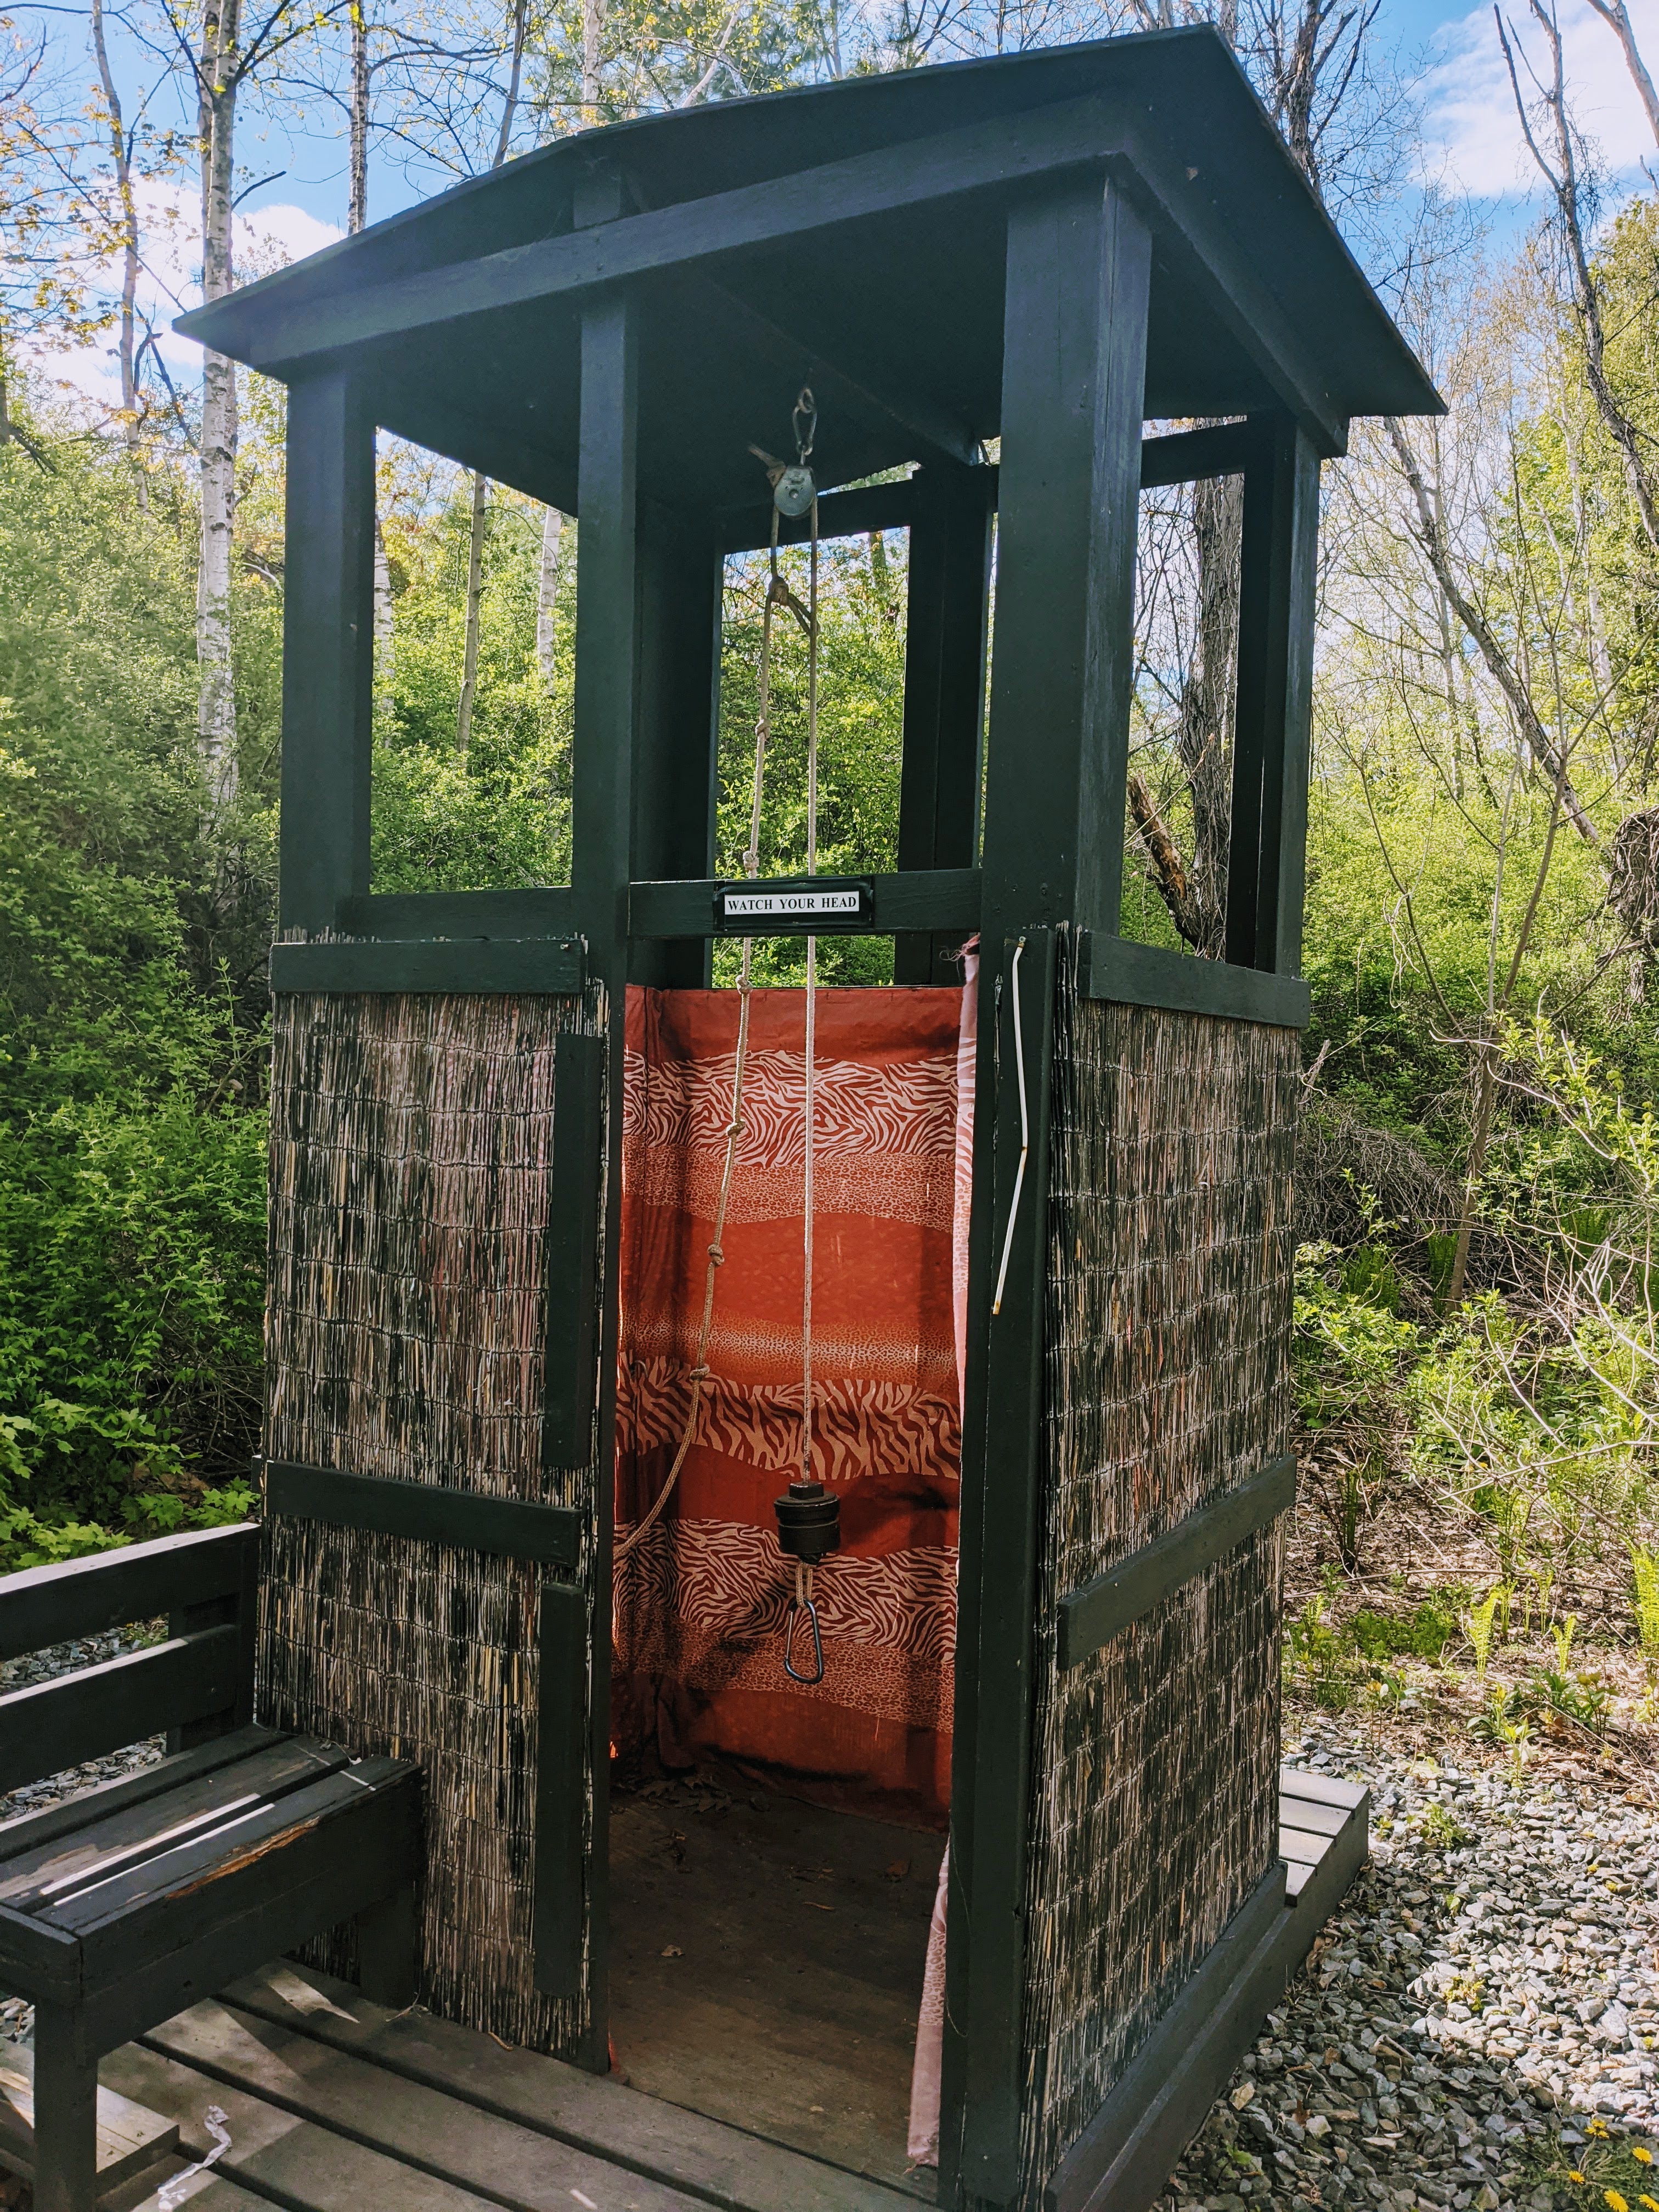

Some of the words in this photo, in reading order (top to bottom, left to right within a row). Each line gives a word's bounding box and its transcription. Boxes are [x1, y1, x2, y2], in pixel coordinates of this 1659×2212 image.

[728, 899, 772, 911] WATCH
[780, 898, 815, 909] YOUR
[822, 896, 856, 908] HEAD
